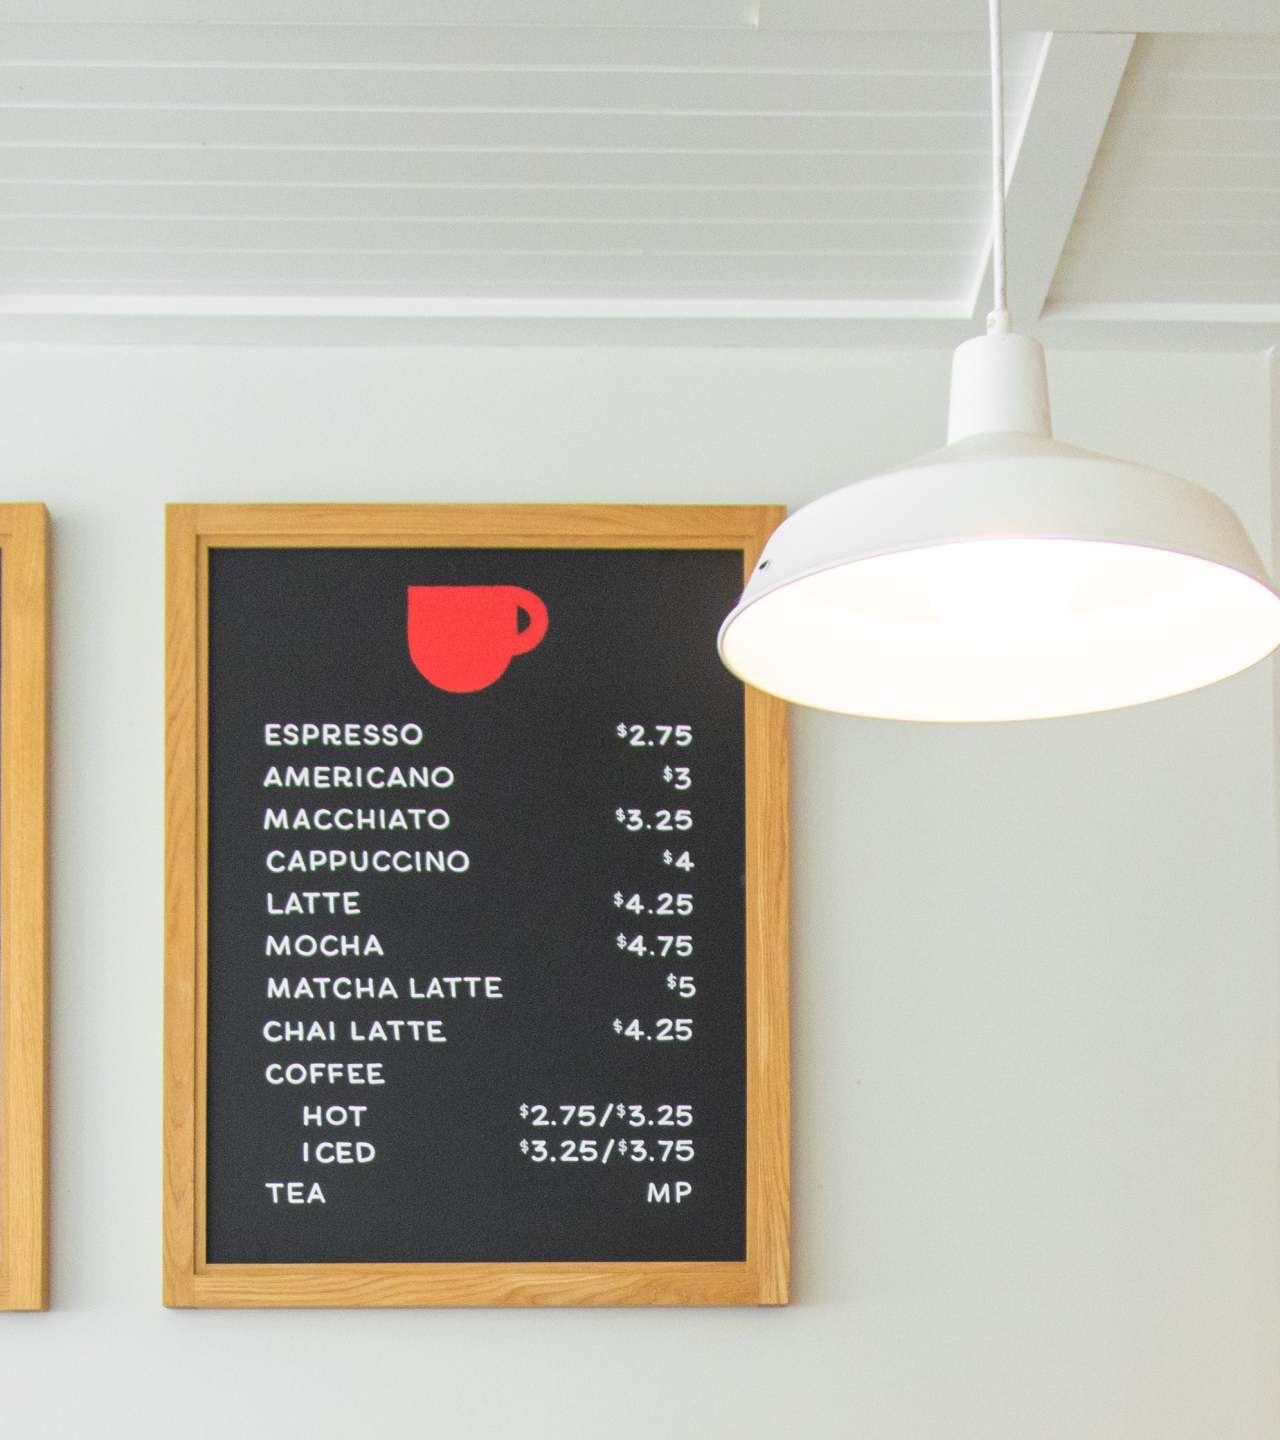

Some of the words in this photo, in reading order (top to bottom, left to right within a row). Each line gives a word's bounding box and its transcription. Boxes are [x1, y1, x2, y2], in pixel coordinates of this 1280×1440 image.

[264, 722, 424, 747] ESPRESSO
[616, 722, 693, 747] $2.75
[262, 765, 455, 789] AMERICANO
[662, 764, 692, 791] $3
[263, 807, 451, 831] MACCHIATO
[615, 807, 694, 832] $3.25
[265, 849, 470, 874] CAPPUCCINO
[663, 848, 695, 872] $4
[266, 891, 361, 916] LATTE
[613, 890, 694, 916] $4.25
[265, 933, 385, 957] MOCHA
[616, 932, 694, 958] $4.75
[266, 976, 399, 1000] MATCHA
[409, 976, 504, 999] LATTE
[666, 972, 697, 999] $5
[262, 1020, 336, 1043] CHAI
[350, 1019, 447, 1043] LATTE
[612, 1017, 694, 1042] $4.25
[264, 1062, 386, 1086] COFFEE
[302, 1105, 368, 1128] HOT
[519, 1102, 694, 1128] $2.75/$3.25
[302, 1141, 376, 1165] ICED
[519, 1138, 695, 1165] $3.25/$3.75
[264, 1181, 327, 1205] TEA
[646, 1180, 693, 1204] MP
